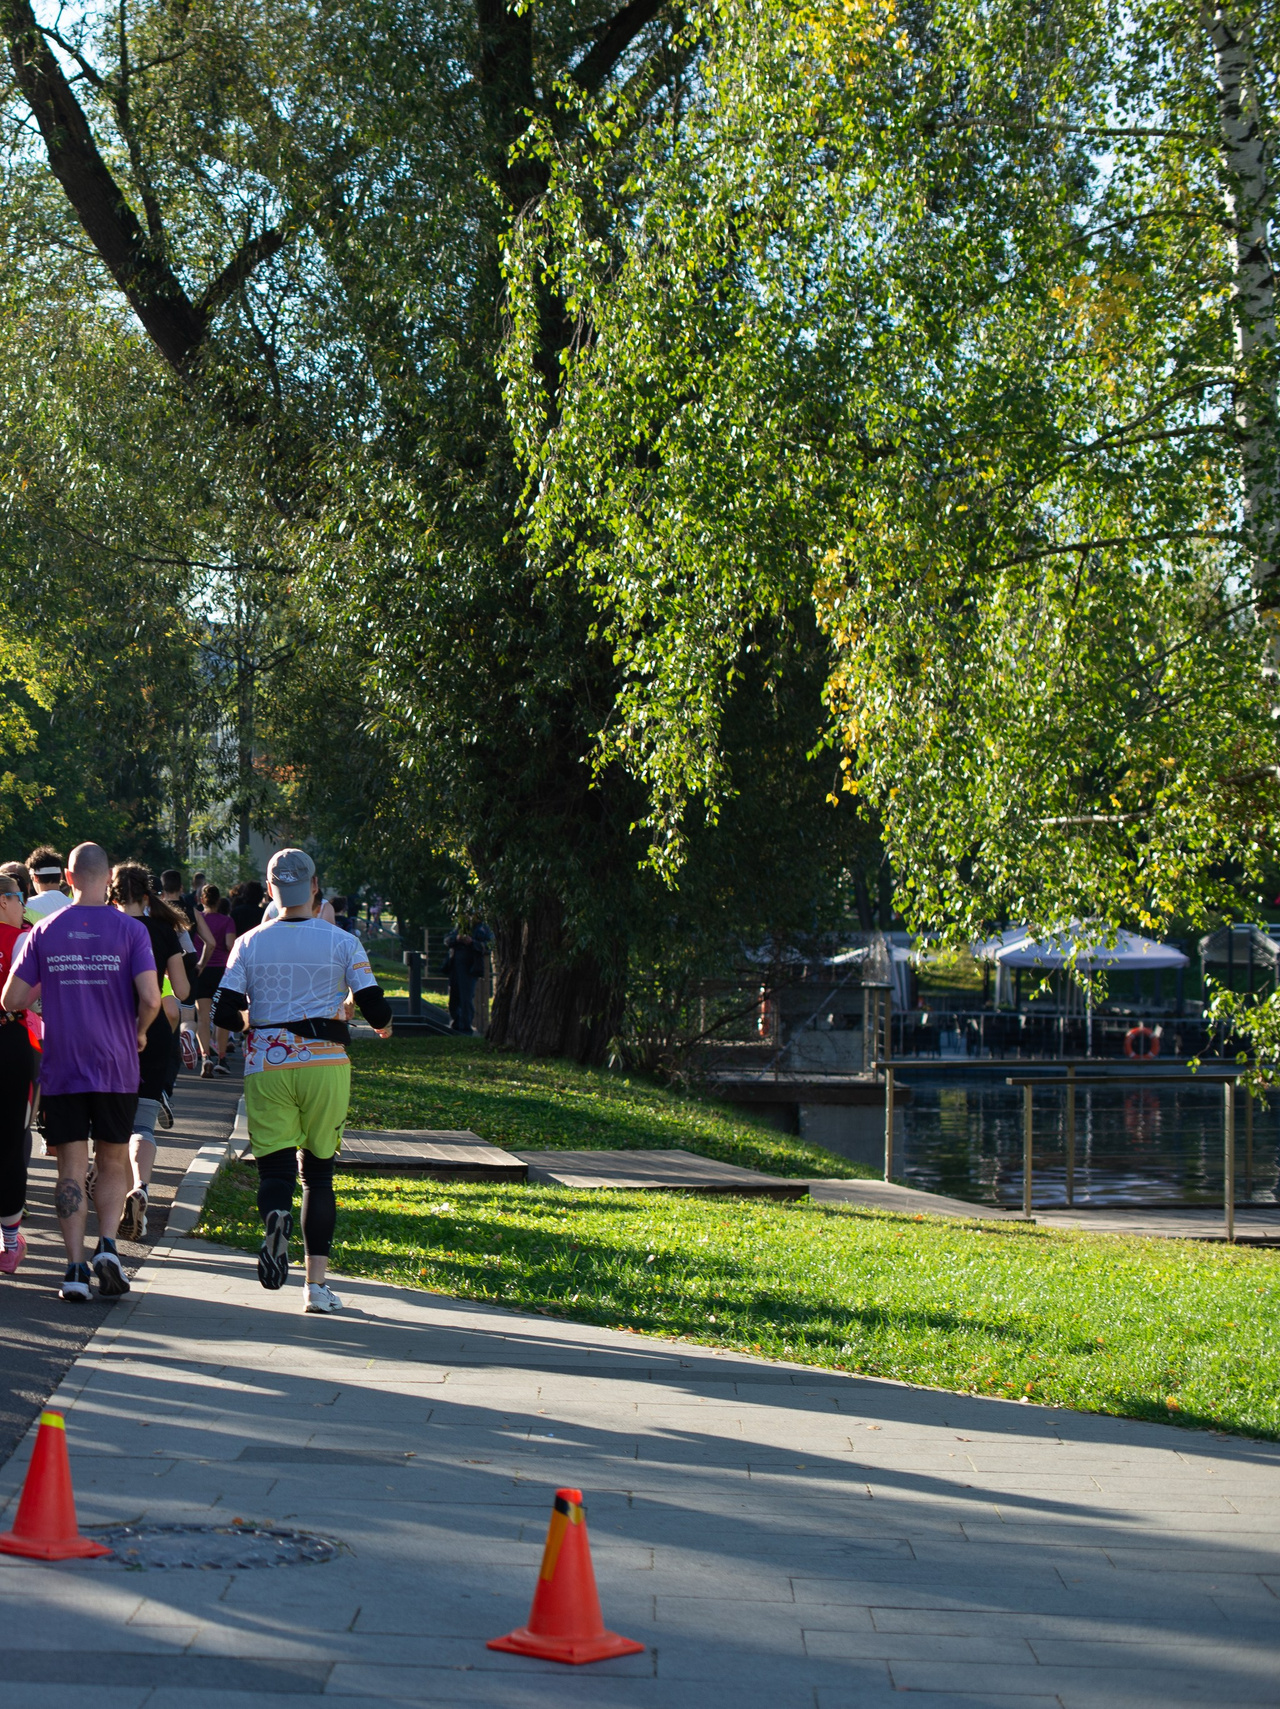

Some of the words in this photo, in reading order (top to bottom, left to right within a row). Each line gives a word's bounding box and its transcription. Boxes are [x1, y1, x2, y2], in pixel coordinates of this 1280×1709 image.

[47, 954, 83, 963] МОСКВА
[91, 954, 121, 963] ГОРОД
[48, 962, 120, 972] ВОЗМОЖНОСТЕЙ
